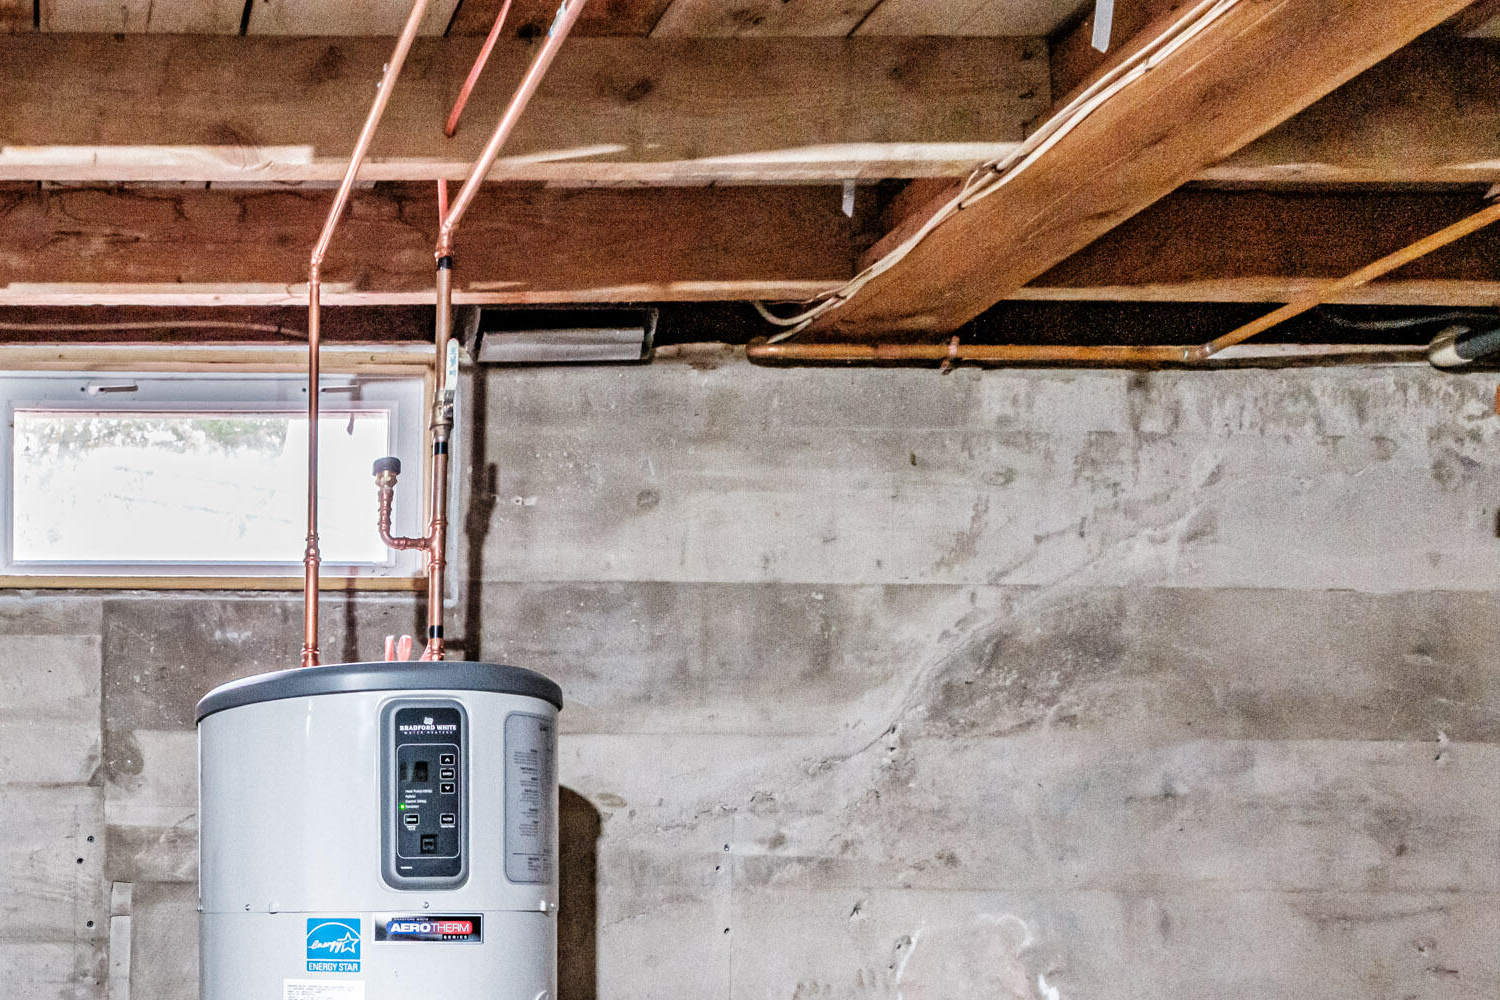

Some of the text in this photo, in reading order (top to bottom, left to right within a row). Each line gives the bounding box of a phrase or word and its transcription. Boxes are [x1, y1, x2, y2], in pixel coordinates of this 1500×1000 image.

[390, 923, 469, 933] AEROTHERM
[308, 962, 359, 972] ENERGY STAR
